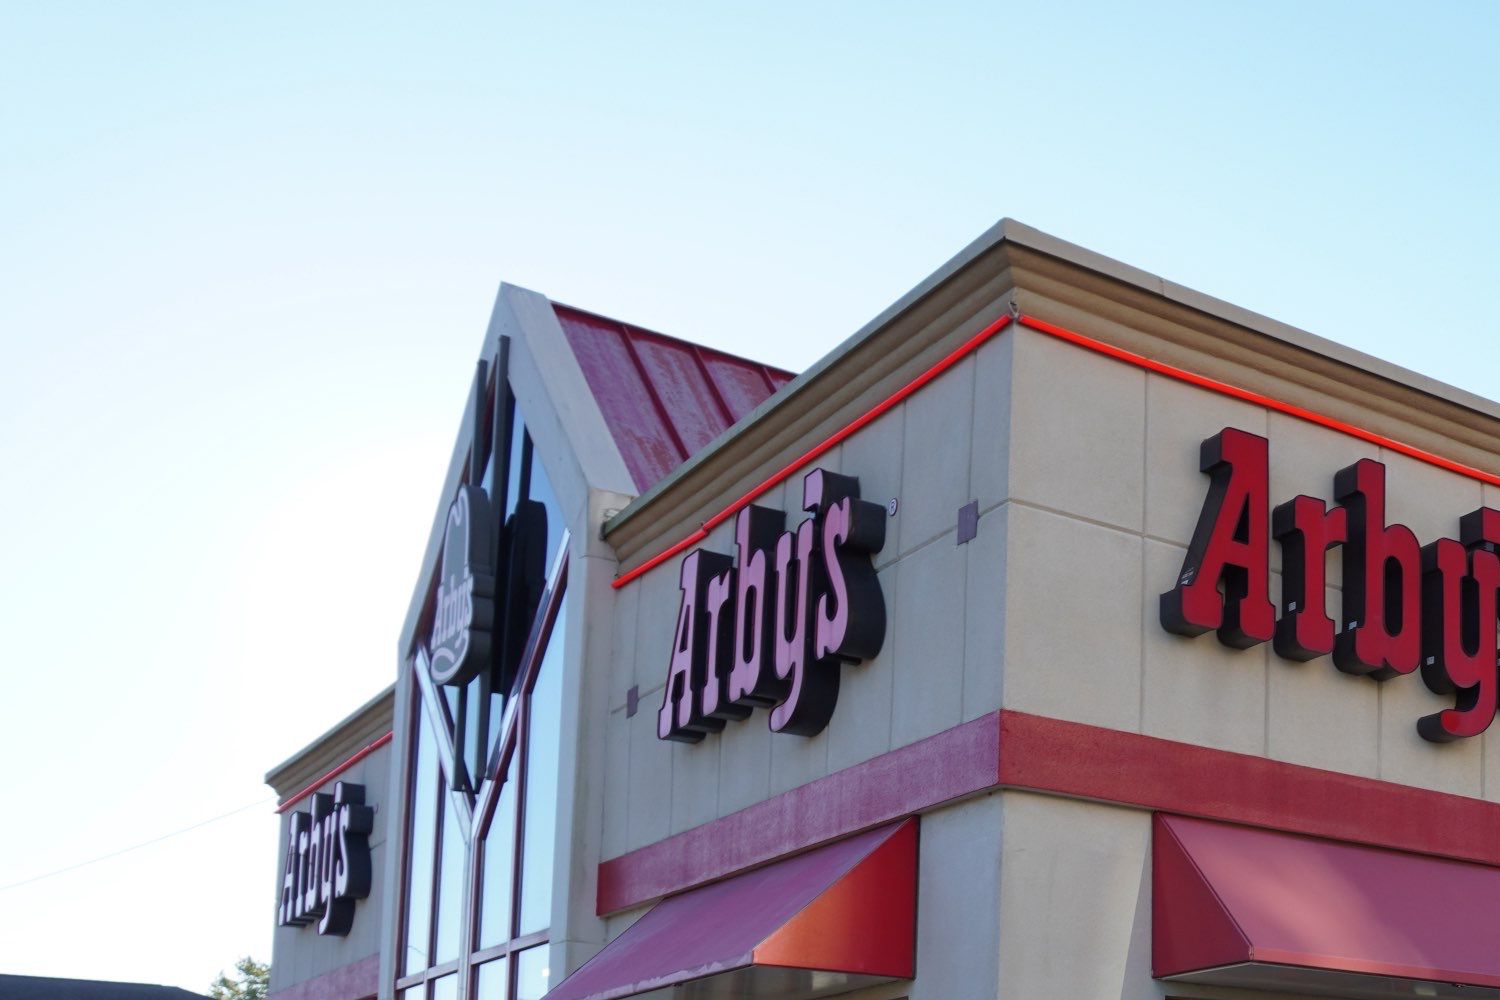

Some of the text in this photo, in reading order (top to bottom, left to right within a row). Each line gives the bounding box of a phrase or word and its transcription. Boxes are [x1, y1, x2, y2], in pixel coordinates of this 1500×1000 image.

[429, 571, 475, 652] Arby's
[657, 467, 856, 741] Arby's
[278, 780, 354, 936] Arby's
